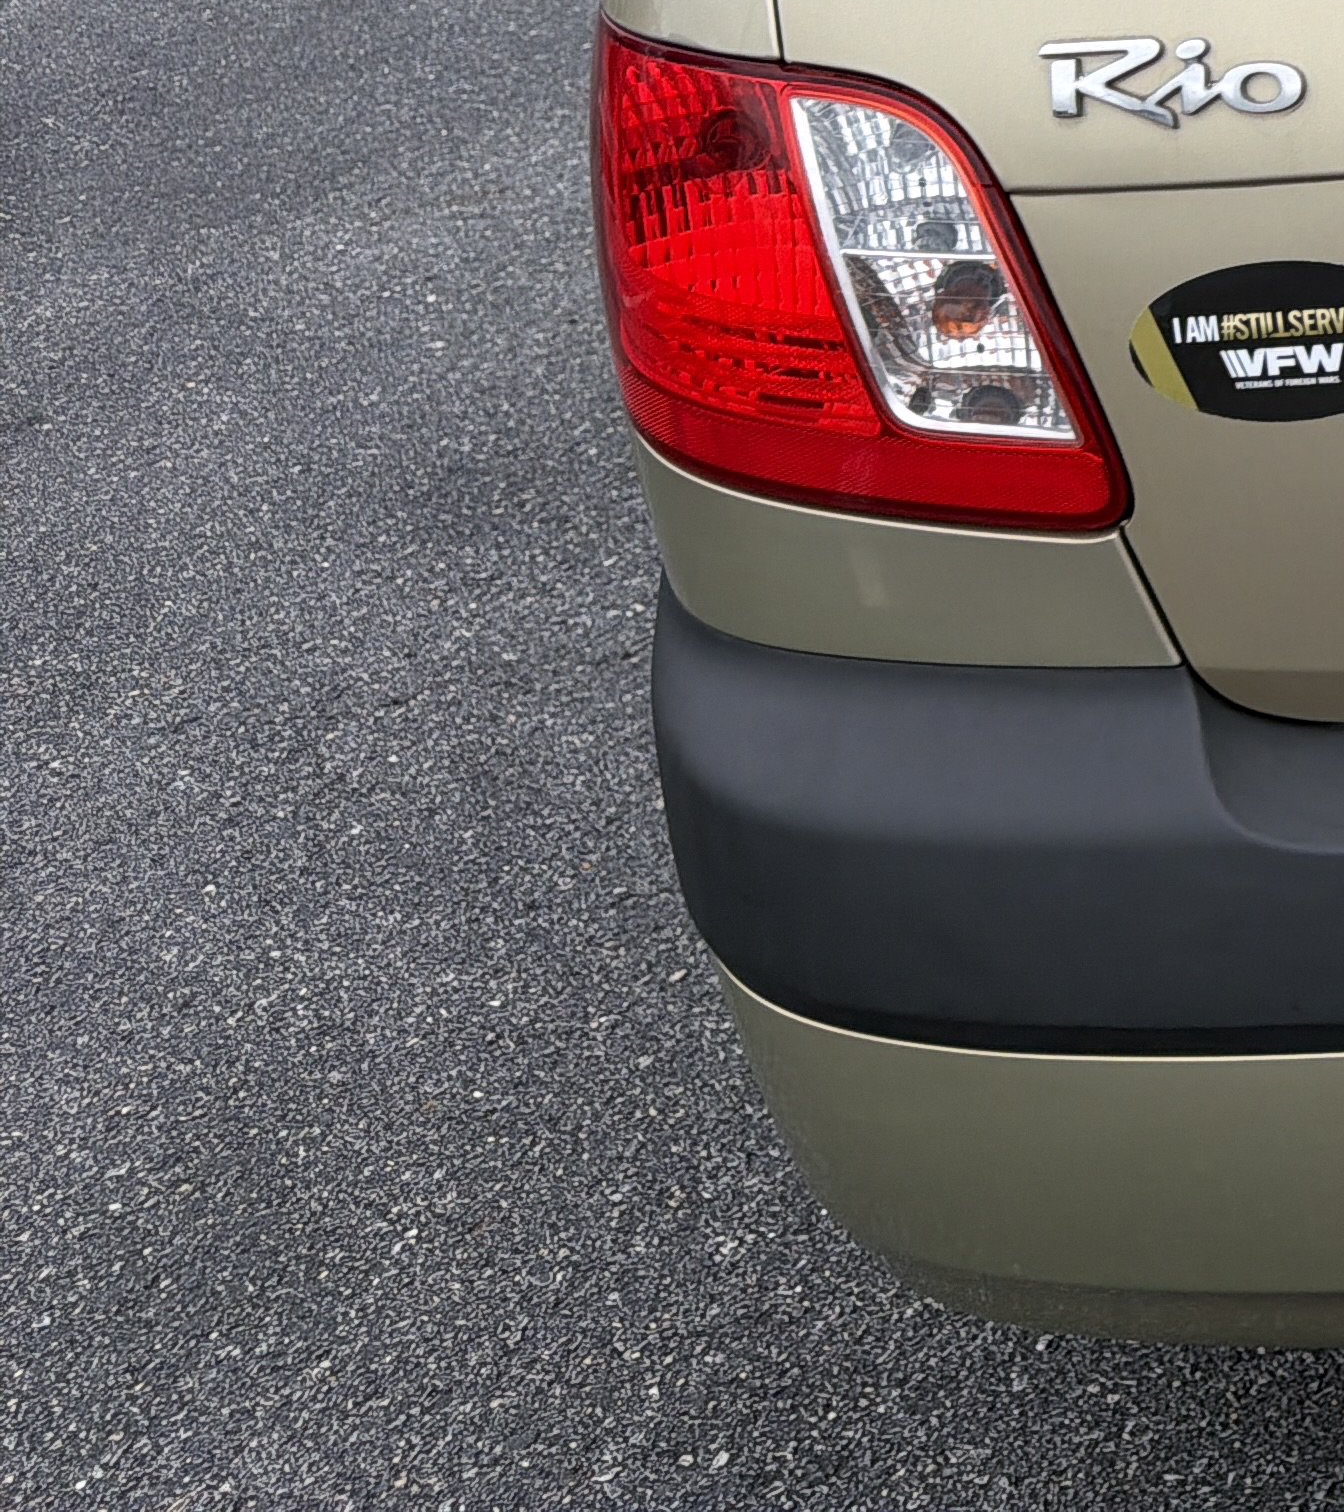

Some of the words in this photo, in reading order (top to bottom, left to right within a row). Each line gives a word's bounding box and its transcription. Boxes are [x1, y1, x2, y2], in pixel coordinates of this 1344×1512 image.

[1038, 37, 1307, 128] Rio
[1172, 317, 1182, 343] I
[1185, 315, 1220, 342] AM
[1220, 343, 1344, 378] VFW
